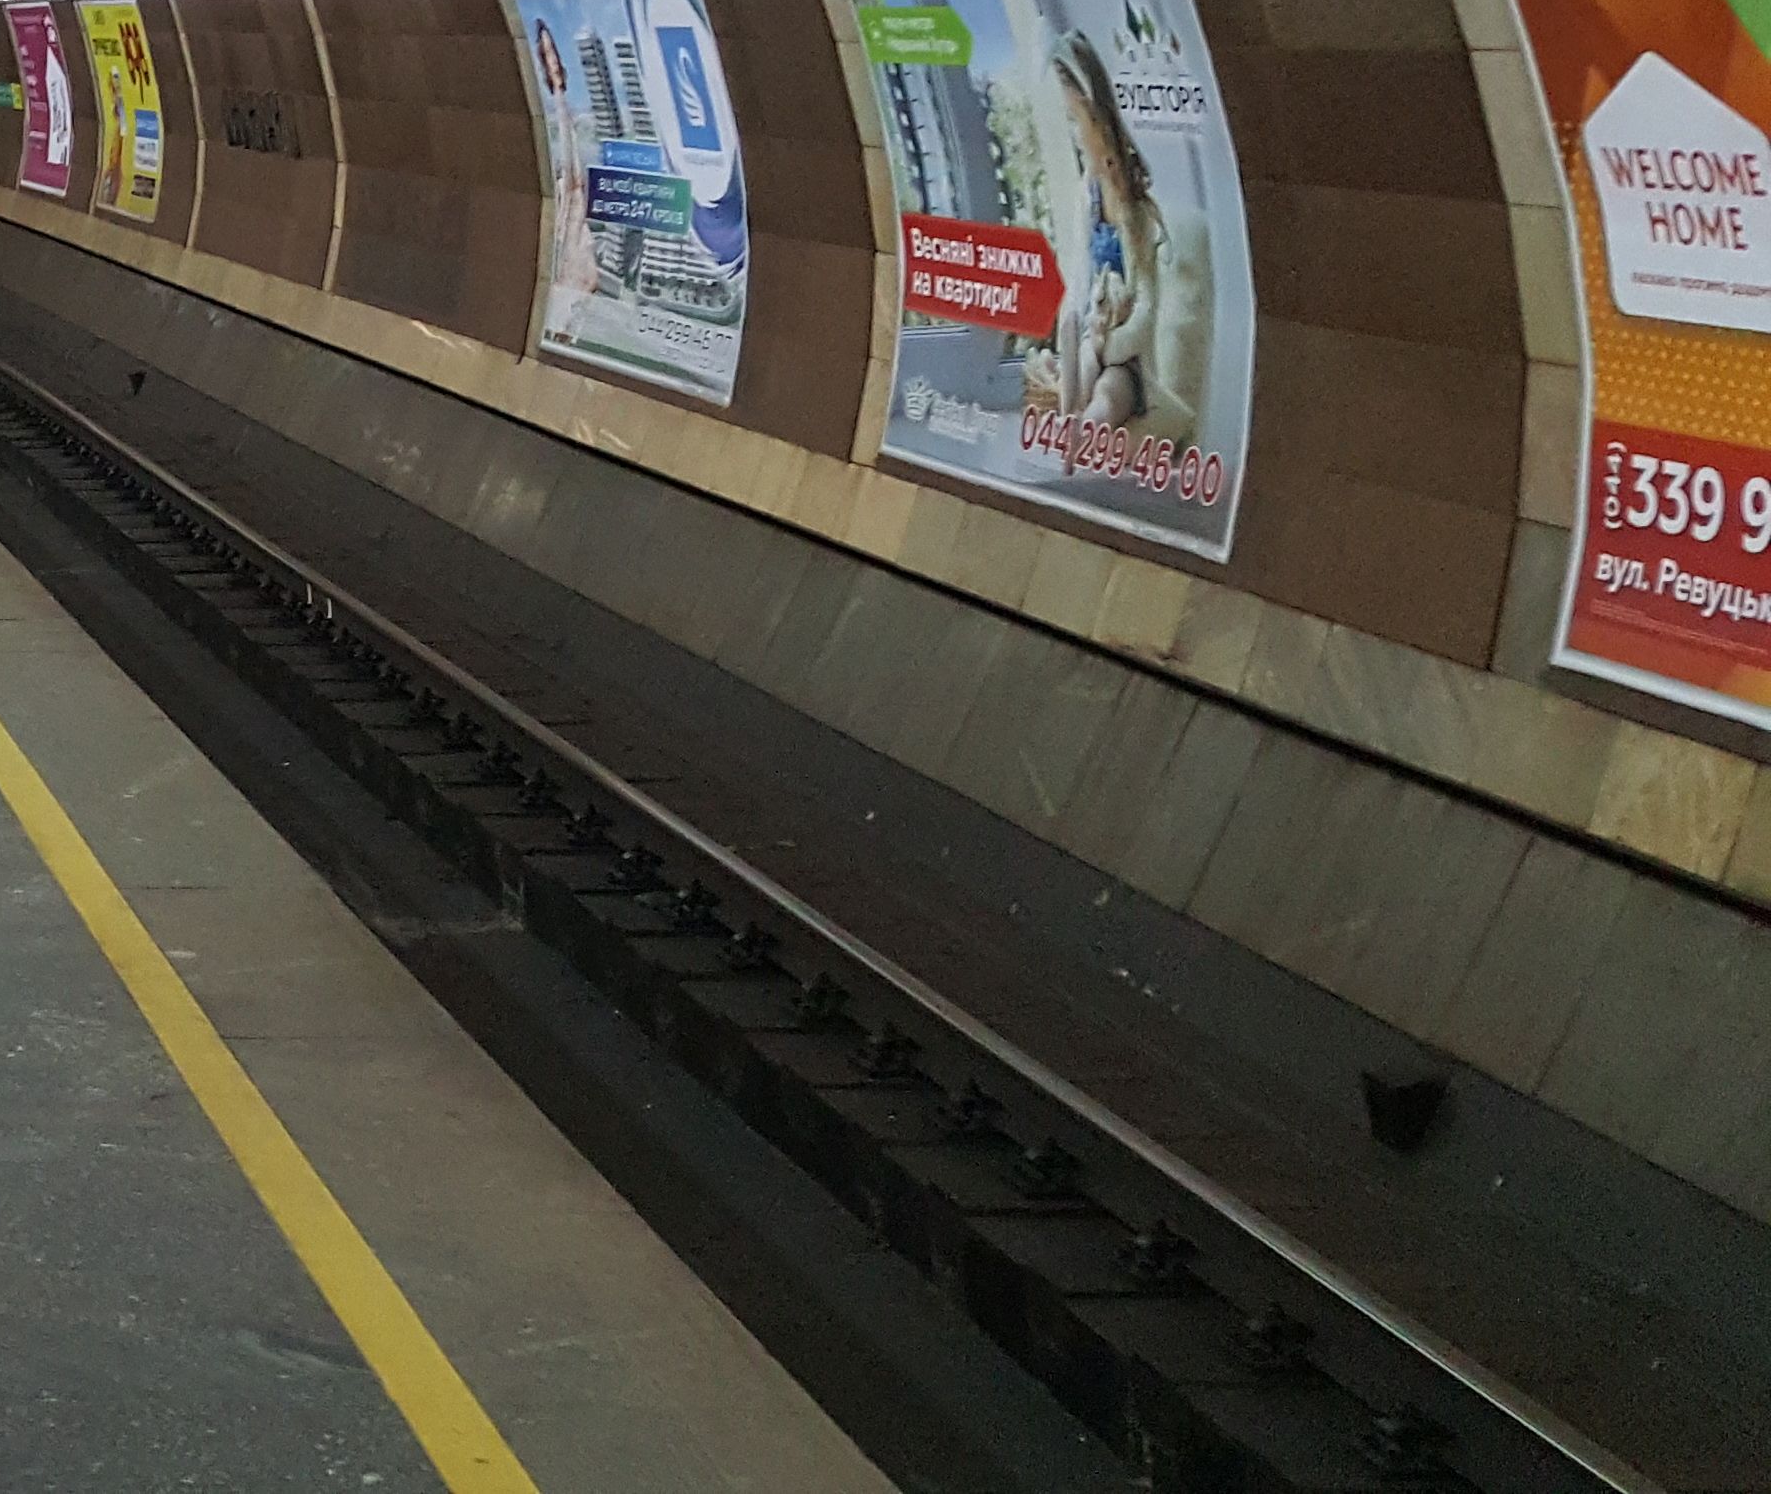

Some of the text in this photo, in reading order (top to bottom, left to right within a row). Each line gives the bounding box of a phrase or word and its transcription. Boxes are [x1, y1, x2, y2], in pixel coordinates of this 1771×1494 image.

[1600, 146, 1768, 197] WELCOME
[1644, 201, 1750, 251] HOME
[910, 227, 1044, 279] Весняні знижки
[912, 270, 1021, 317] на квартири!
[1021, 404, 1077, 476] 044
[1075, 419, 1129, 479] 299
[1130, 435, 1175, 493] 46
[1179, 445, 1224, 506] 00
[1625, 453, 1726, 542] 339
[1594, 553, 1650, 593] вул.
